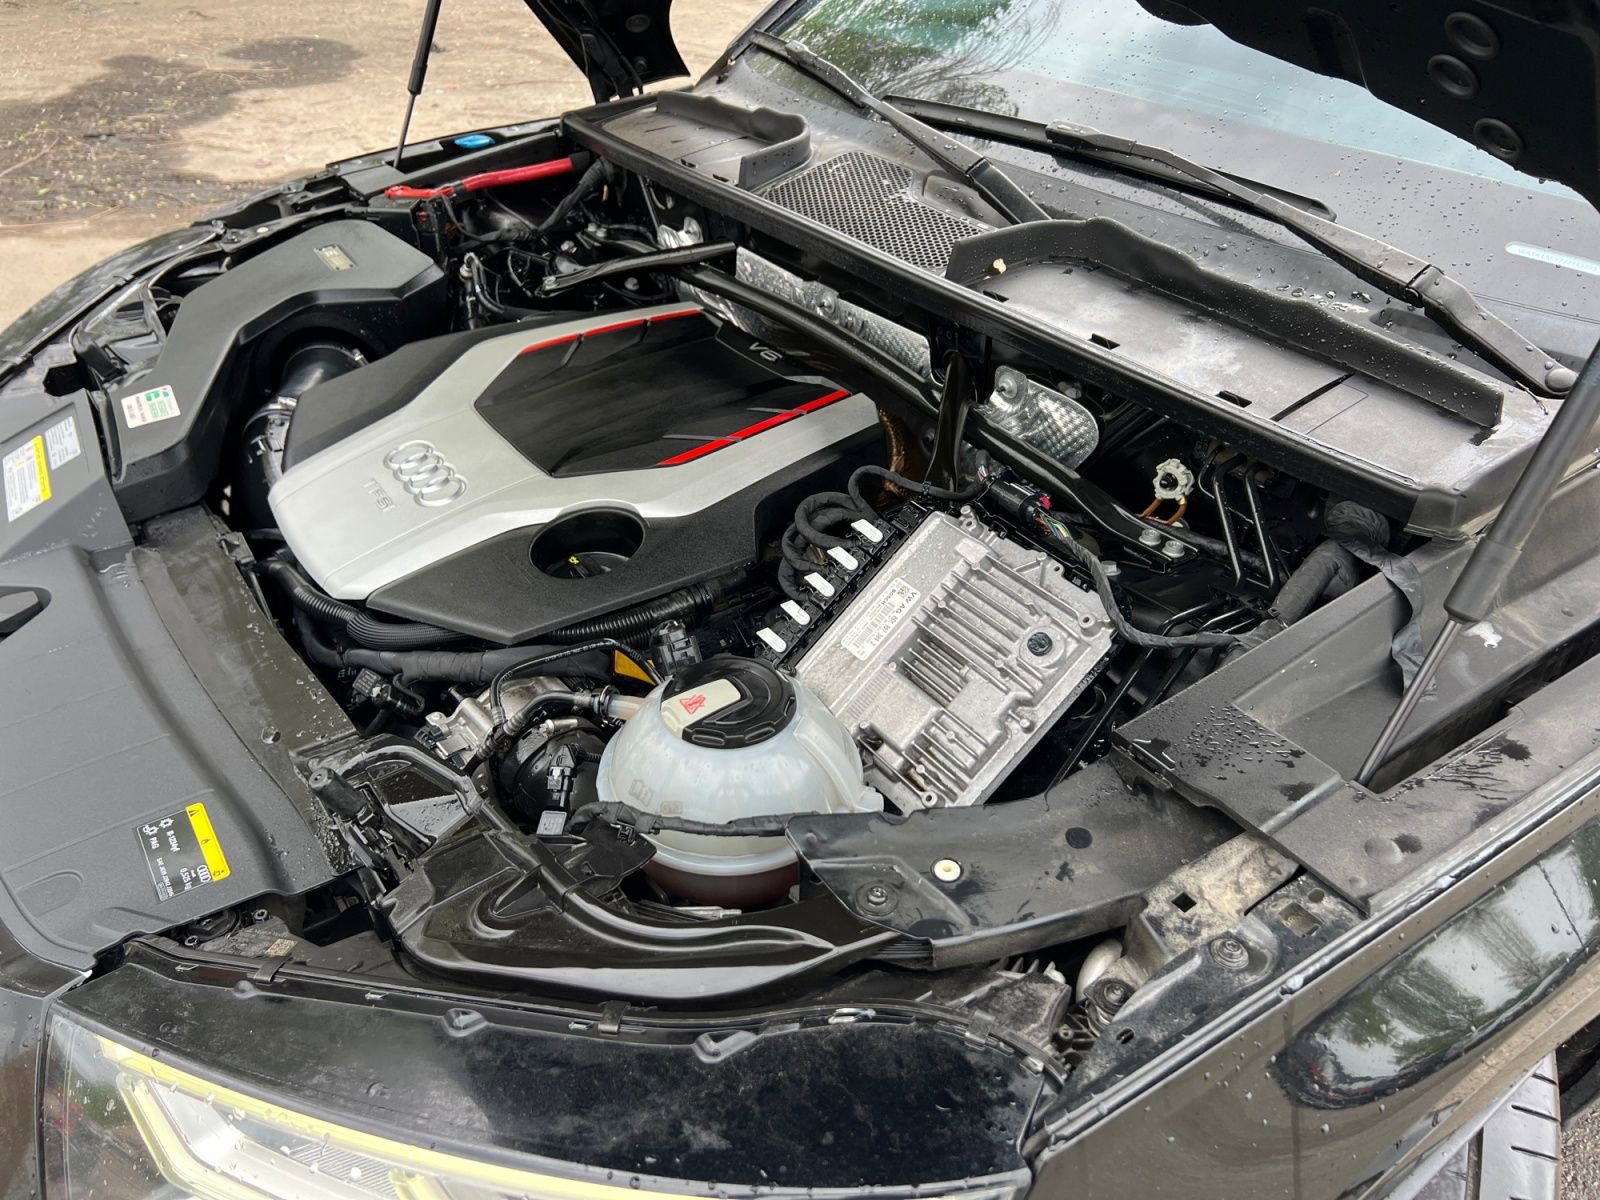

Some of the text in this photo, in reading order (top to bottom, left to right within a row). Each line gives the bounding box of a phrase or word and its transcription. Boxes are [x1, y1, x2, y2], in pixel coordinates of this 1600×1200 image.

[749, 341, 783, 362] V6
[363, 477, 397, 513] TFSI
[905, 591, 917, 604] VW
[895, 603, 906, 614] AG
[149, 836, 160, 849] PAG
